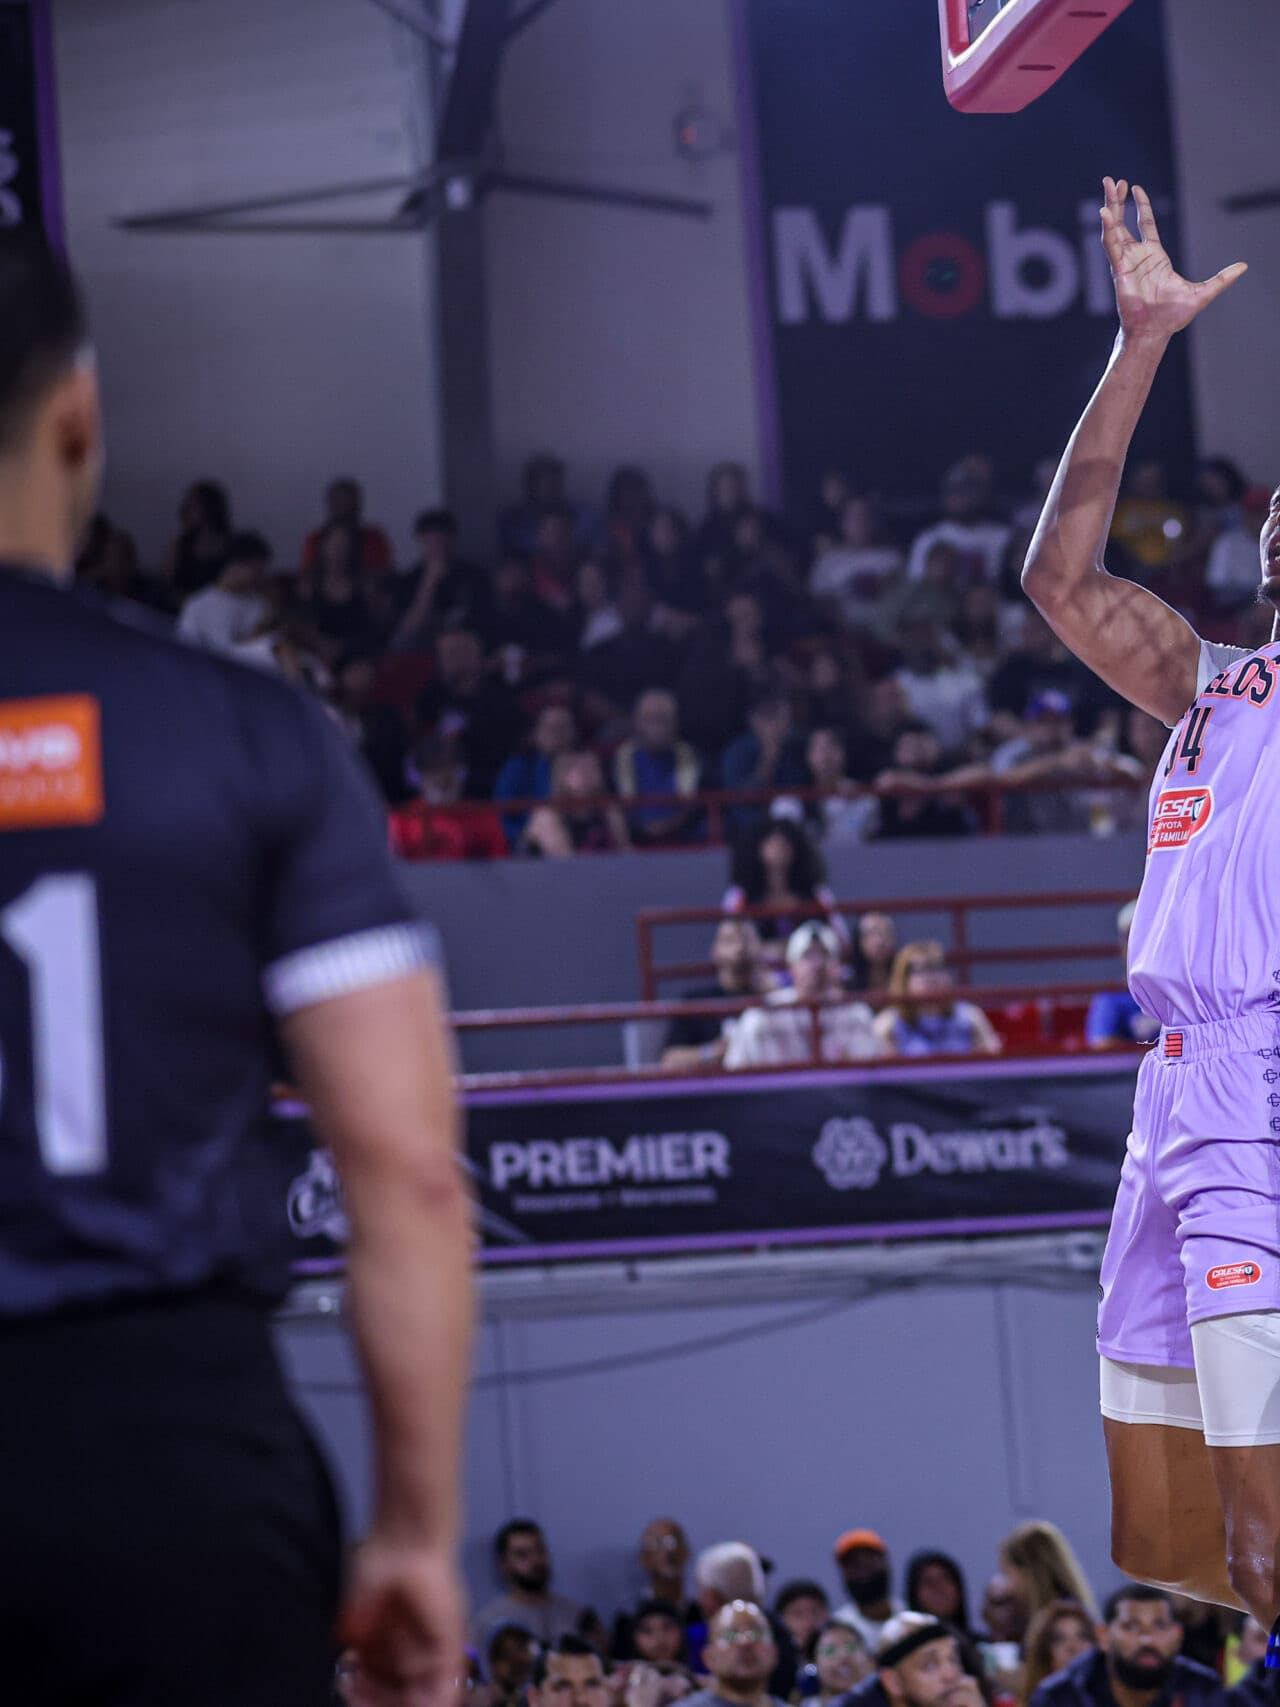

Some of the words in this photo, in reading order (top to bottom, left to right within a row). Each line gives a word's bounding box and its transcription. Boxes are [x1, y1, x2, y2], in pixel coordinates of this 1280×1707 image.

[772, 205, 1138, 322] Mobi
[0, 870, 108, 1173] 1
[489, 1130, 731, 1191] PREMIER
